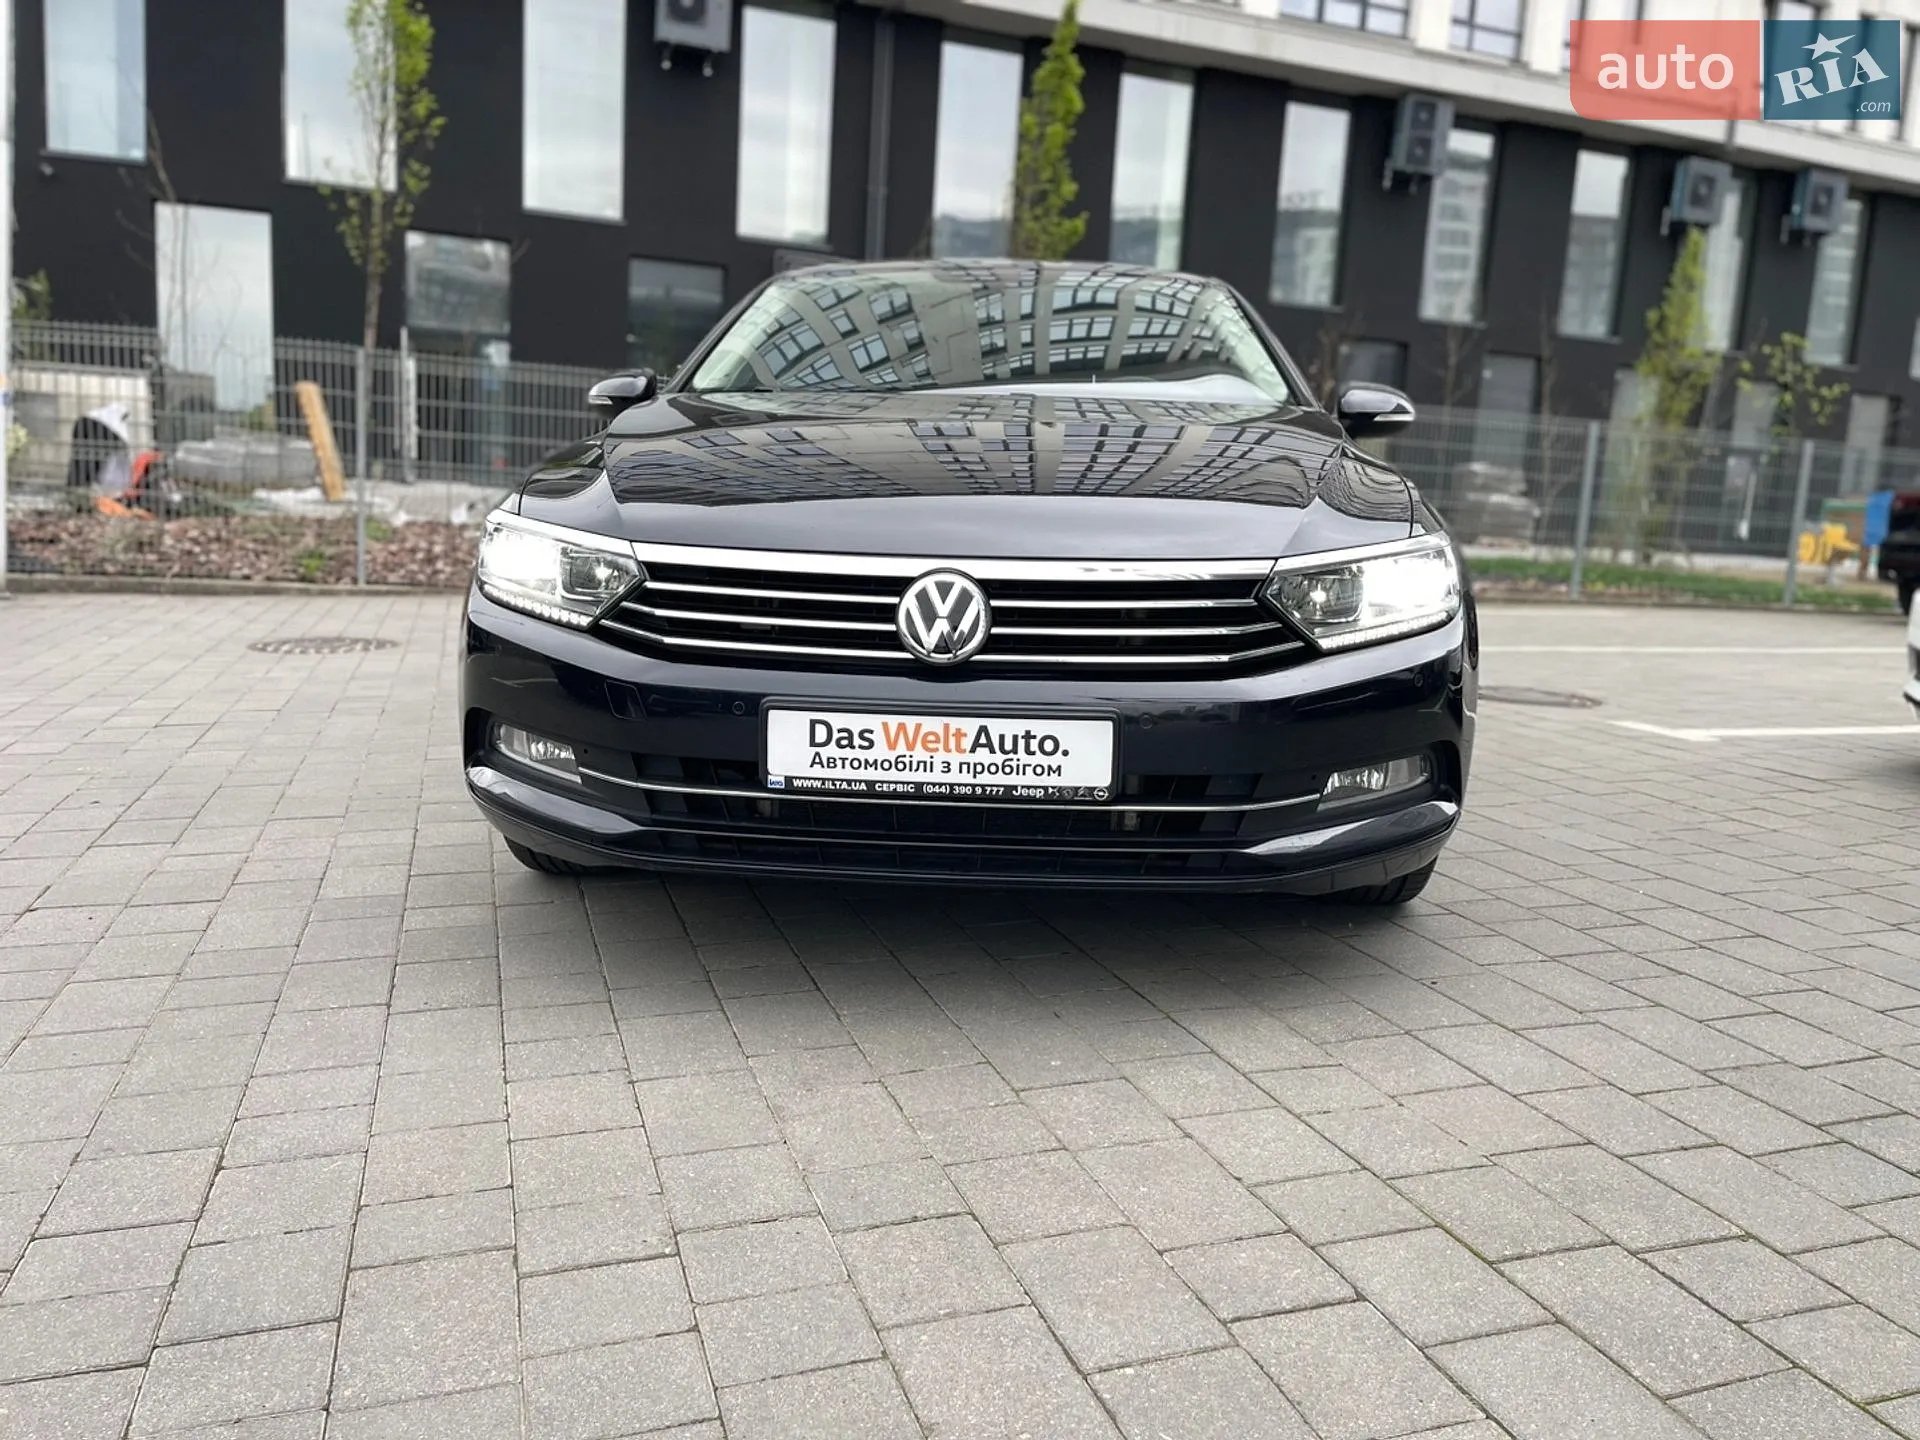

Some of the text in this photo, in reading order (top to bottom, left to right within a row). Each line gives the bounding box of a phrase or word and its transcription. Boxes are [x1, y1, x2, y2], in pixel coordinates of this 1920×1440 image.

[808, 719, 876, 751] Das
[809, 751, 1062, 779] Автомобілі з пробігом
[792, 778, 868, 791] WWW.ILTA.UA
[875, 782, 916, 792] СЕРВІС
[923, 784, 1005, 796] (044) 390 9 777
[1012, 786, 1045, 799] Jeep
